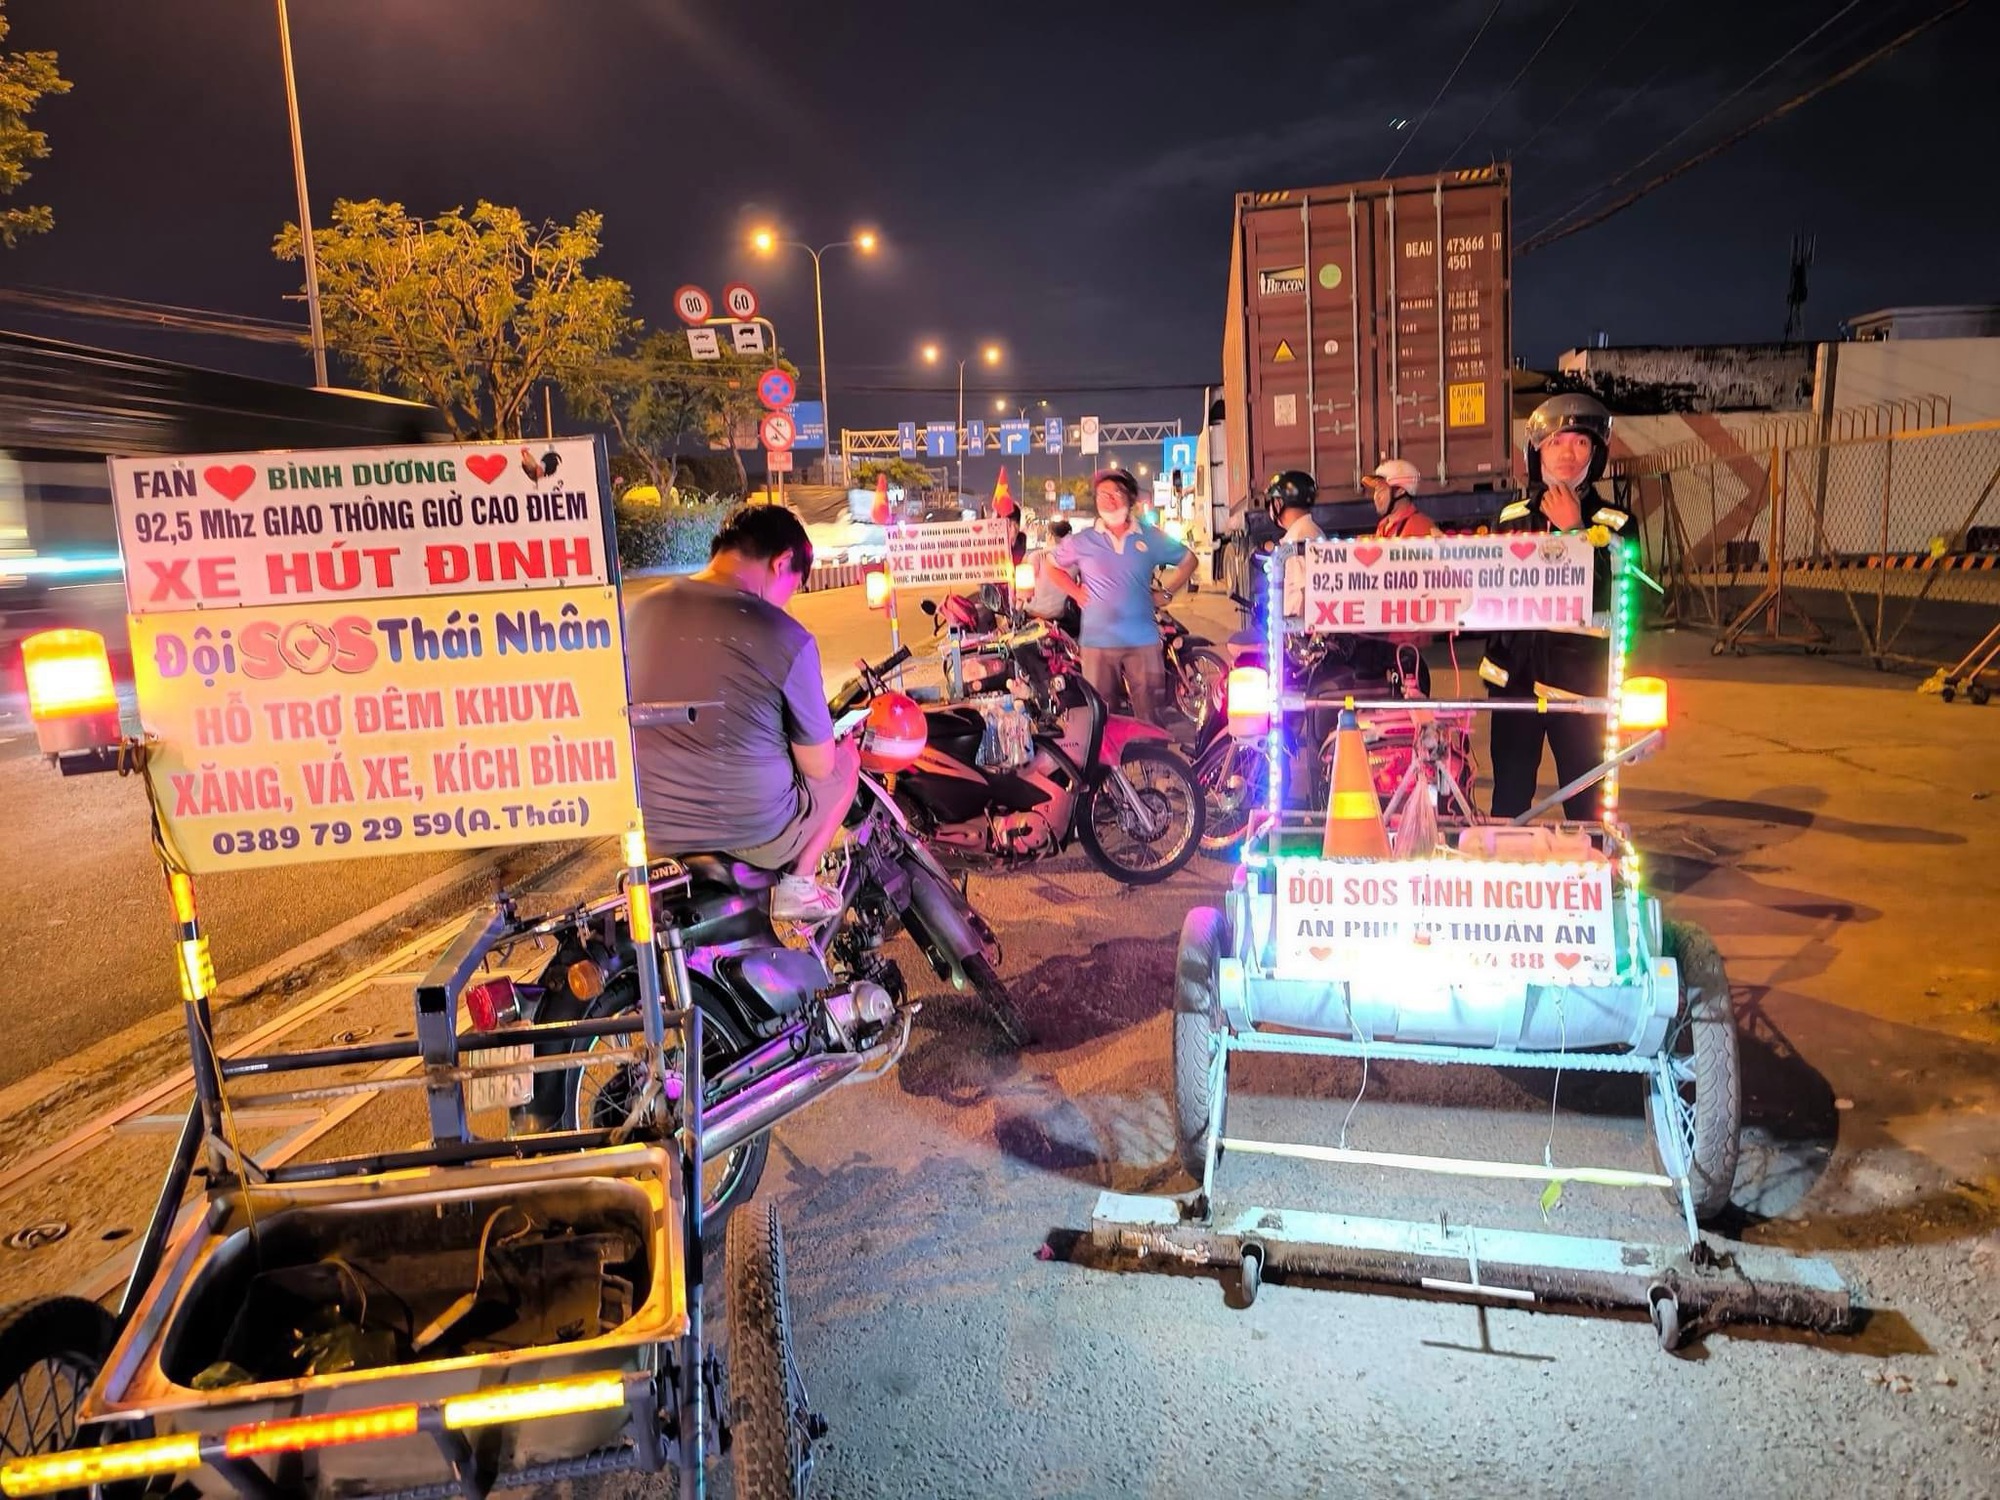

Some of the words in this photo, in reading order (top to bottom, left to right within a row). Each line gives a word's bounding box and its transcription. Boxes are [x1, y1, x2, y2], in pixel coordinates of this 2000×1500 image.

[1405, 241, 1432, 258] BEAU
[1446, 235, 1484, 253] 473666
[1447, 254, 1472, 271] 4501
[1266, 278, 1305, 295] BEACON
[685, 297, 702, 312] 80
[734, 294, 749, 310] 60
[1451, 385, 1483, 399] CAUTION
[133, 467, 197, 500] FAN
[267, 460, 343, 491] BÌNH
[353, 459, 457, 488] DƯƠNG
[135, 511, 193, 547] 92,5
[201, 508, 256, 540] Mhz
[263, 505, 323, 537] GIAO
[331, 496, 414, 532] THÔNG
[422, 489, 463, 527] GIỜ
[471, 497, 519, 525] CAO
[526, 480, 588, 522] ĐIỂM
[892, 556, 914, 571] XE
[1389, 545, 1433, 561] BÌNH
[144, 556, 241, 602] XE
[265, 541, 401, 595] HÚT
[424, 538, 593, 585] ĐINH
[1312, 572, 1343, 593] 92,5
[1348, 571, 1379, 591] Mhz
[1383, 569, 1418, 590] GIAO
[1422, 565, 1473, 590] THÔNG
[1478, 563, 1505, 588] GIỜ
[1509, 566, 1540, 587] CAO
[1545, 558, 1585, 587] ĐIỂM
[1314, 599, 1366, 625] XE
[1381, 593, 1462, 625] HÚT
[155, 627, 235, 687] Đội
[238, 615, 379, 681] SOS
[377, 608, 481, 665] Thái
[495, 603, 612, 656] Nhân
[194, 692, 252, 747] HỖ
[264, 693, 342, 746] TRỢ
[355, 684, 445, 734] ĐÊM
[458, 681, 580, 726] KHUYA
[170, 759, 293, 817] XĂNG,
[302, 752, 356, 806] VÁ
[362, 755, 424, 802] XE,
[434, 743, 519, 795] KÍCH
[532, 740, 616, 786] BÌNH
[212, 826, 300, 855] 0389
[310, 821, 352, 847] 79
[362, 817, 403, 842] 29
[1343, 877, 1398, 907] SOS
[1297, 919, 1334, 938] AN
[1555, 925, 1596, 945] AN
